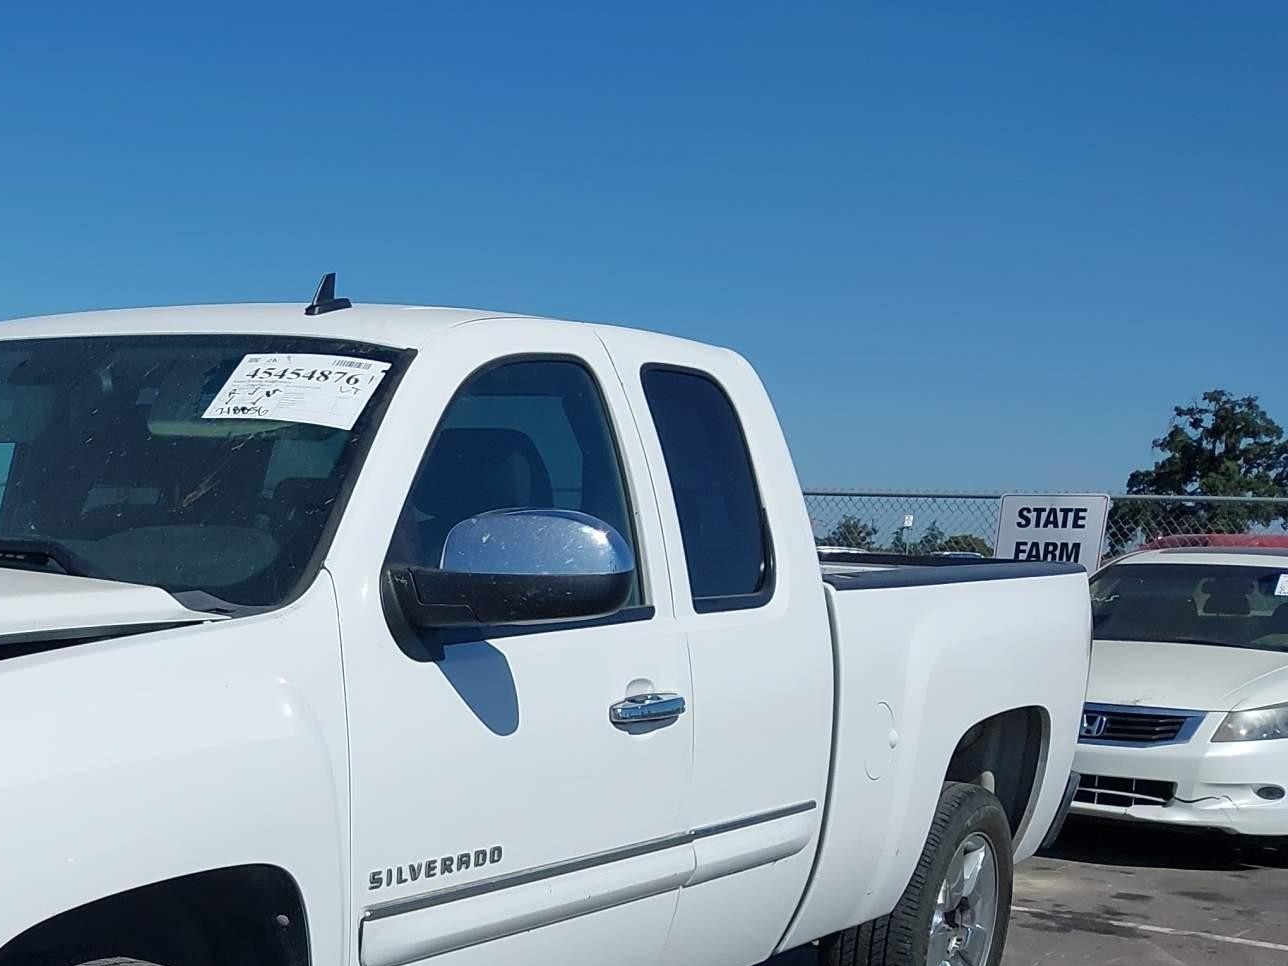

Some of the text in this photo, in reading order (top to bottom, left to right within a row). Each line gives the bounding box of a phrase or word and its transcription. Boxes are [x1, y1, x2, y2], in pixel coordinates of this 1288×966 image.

[246, 367, 361, 386] 45454876
[1015, 506, 1089, 529] STATE
[1013, 541, 1082, 564] FARM
[368, 845, 503, 891] SILVERADO
